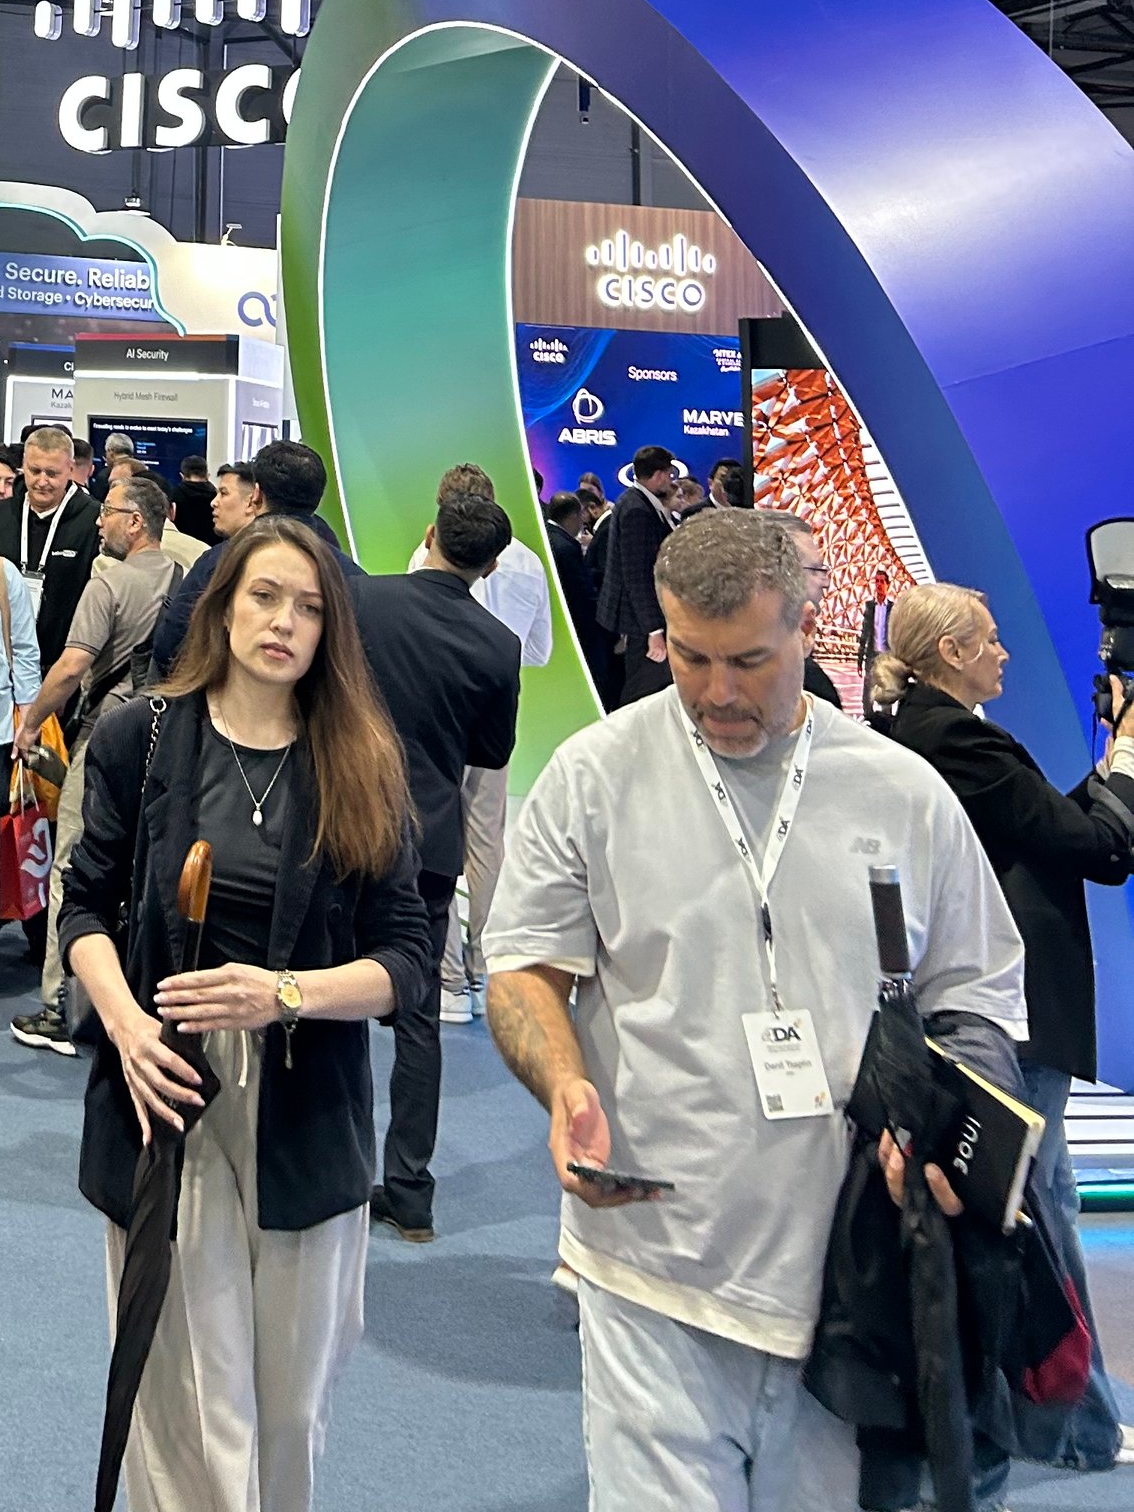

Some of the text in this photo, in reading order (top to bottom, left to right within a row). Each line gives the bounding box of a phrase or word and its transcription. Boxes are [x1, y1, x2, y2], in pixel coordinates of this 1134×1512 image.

[59, 64, 300, 155] CISC
[5, 262, 150, 291] Secure. Reliab
[7, 287, 62, 305] Storage
[74, 291, 155, 310] Cybersecur
[601, 276, 704, 309] CISCO
[126, 349, 169, 361] AI Security
[533, 351, 565, 363] CISCO
[628, 366, 678, 381] Sponsors
[52, 388, 74, 399] MA
[114, 392, 178, 402] Hybrid Mesh Firewall
[683, 409, 744, 427] MARVE
[558, 428, 617, 446] ABRIS
[684, 425, 730, 436] Kazakhstan
